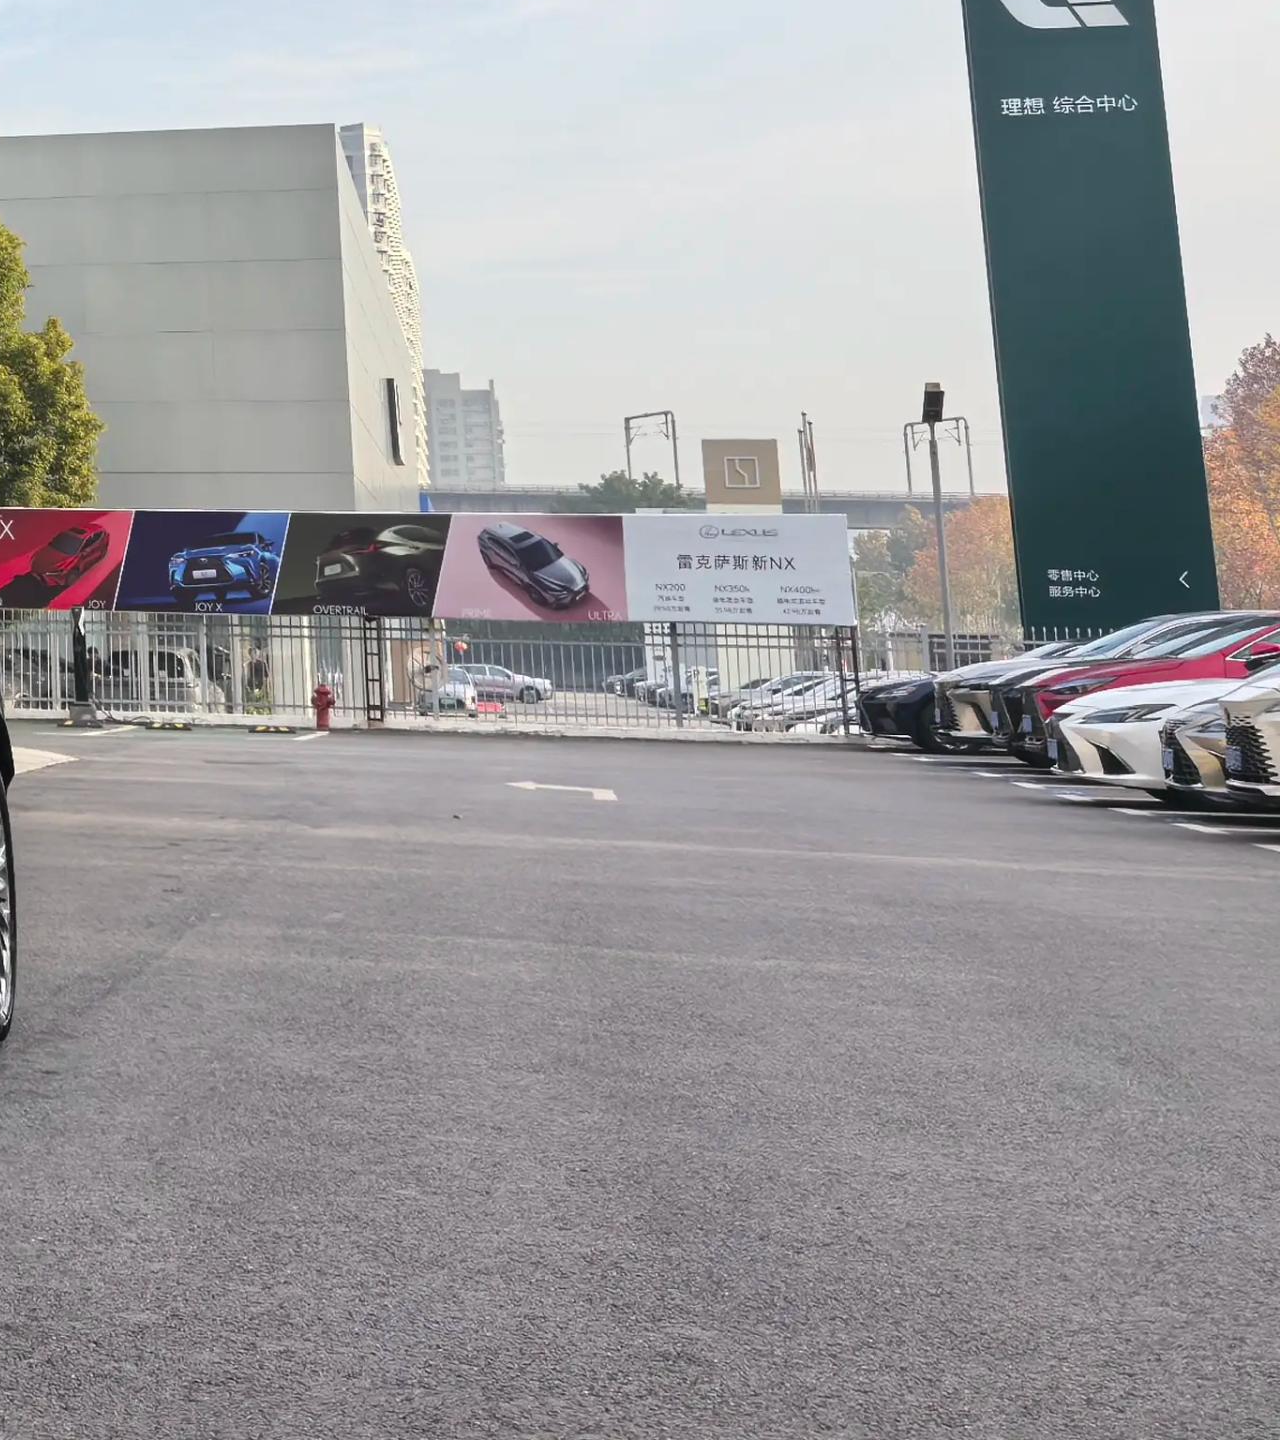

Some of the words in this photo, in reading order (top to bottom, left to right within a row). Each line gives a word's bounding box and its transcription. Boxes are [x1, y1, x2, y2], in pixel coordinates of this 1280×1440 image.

[1000, 97, 1045, 117] 理想
[1053, 94, 1139, 114] 综合中心
[721, 528, 778, 538] LEXUS
[677, 554, 796, 571] 雷克萨斯新NX
[1047, 568, 1100, 582] 零售中心
[655, 583, 686, 593] NX200
[1049, 585, 1101, 598] 服务中心
[87, 599, 107, 609] JOY
[195, 602, 214, 612] JOY
[215, 603, 223, 612] X
[313, 605, 368, 616] OVERTRAIL
[587, 610, 622, 621] ULTRA
